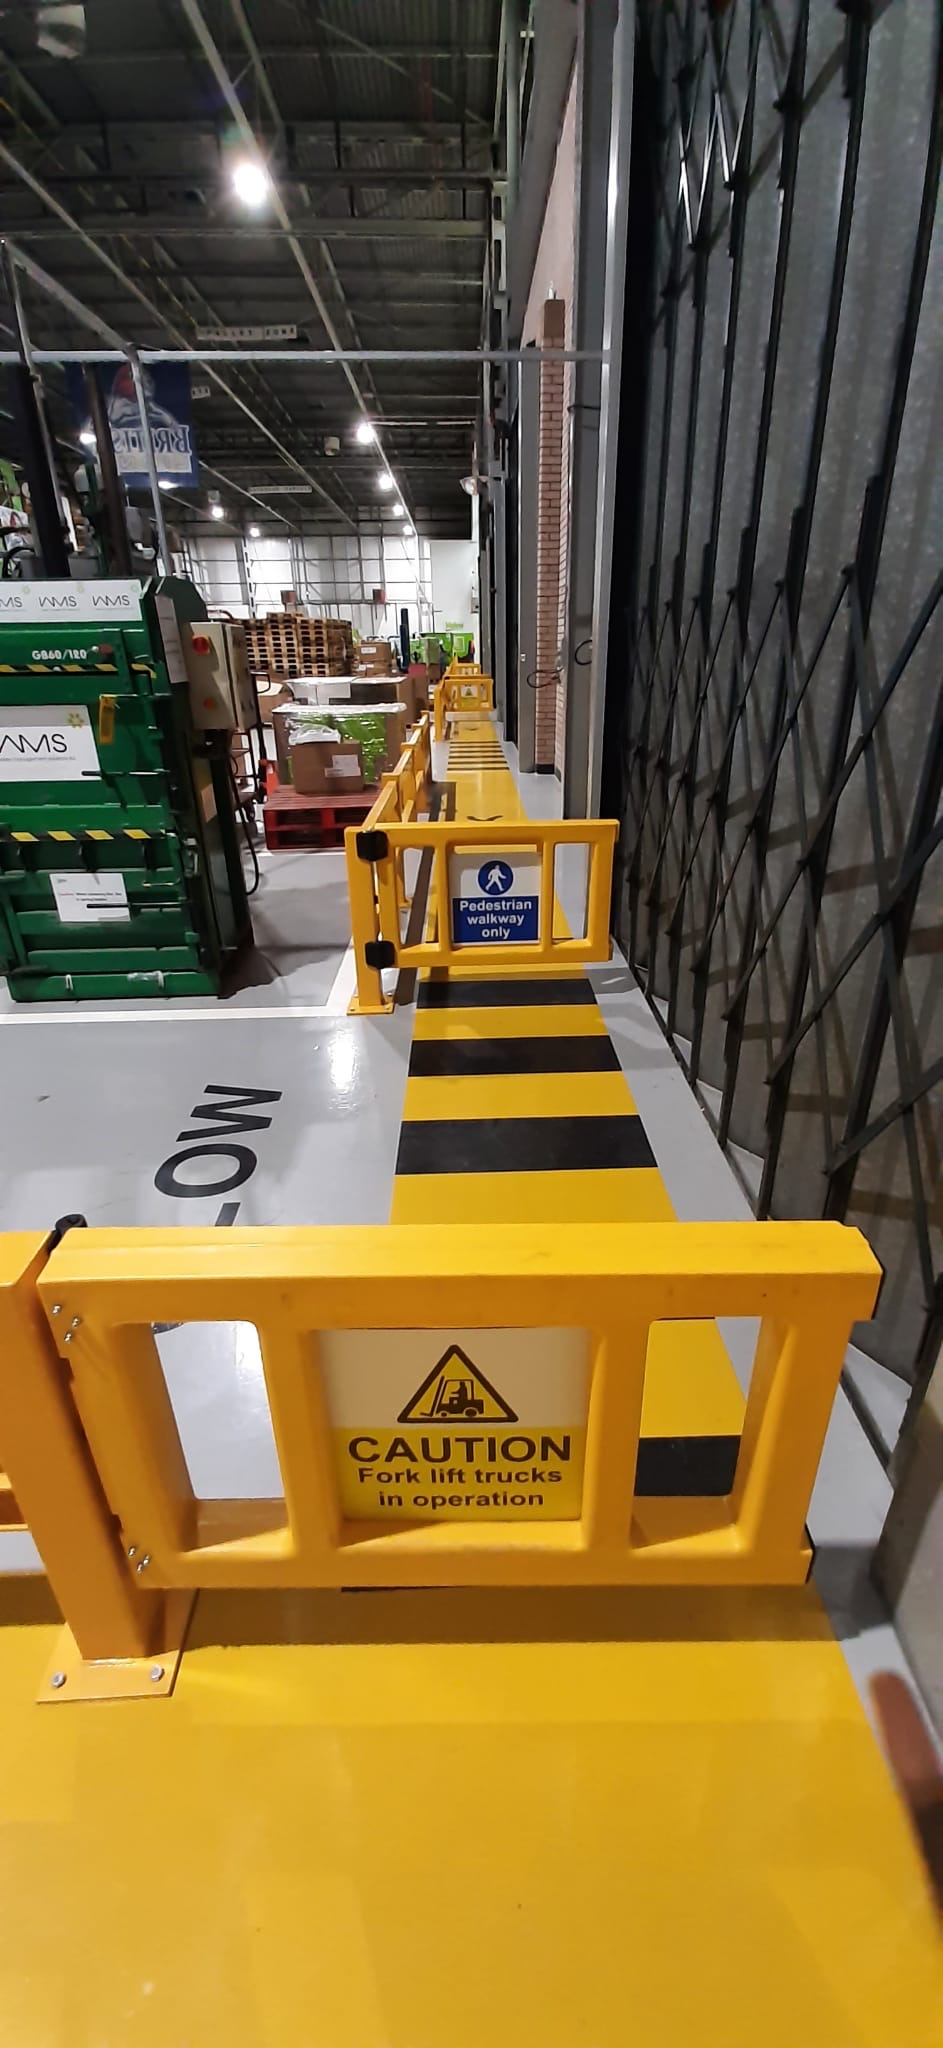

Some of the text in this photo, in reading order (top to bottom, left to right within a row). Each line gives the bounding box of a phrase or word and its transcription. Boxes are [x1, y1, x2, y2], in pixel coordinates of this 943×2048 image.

[38, 595, 78, 608] WMS
[92, 594, 130, 607] WMS
[31, 649, 88, 661] GB60/120
[459, 899, 532, 912] Pedestrian
[467, 913, 525, 926] walkway
[481, 926, 511, 940] only
[154, 1084, 283, 1227] OW
[348, 1435, 572, 1463] CAUTION
[357, 1467, 562, 1484] Fork lift trucks
[378, 1491, 545, 1510] in operation
